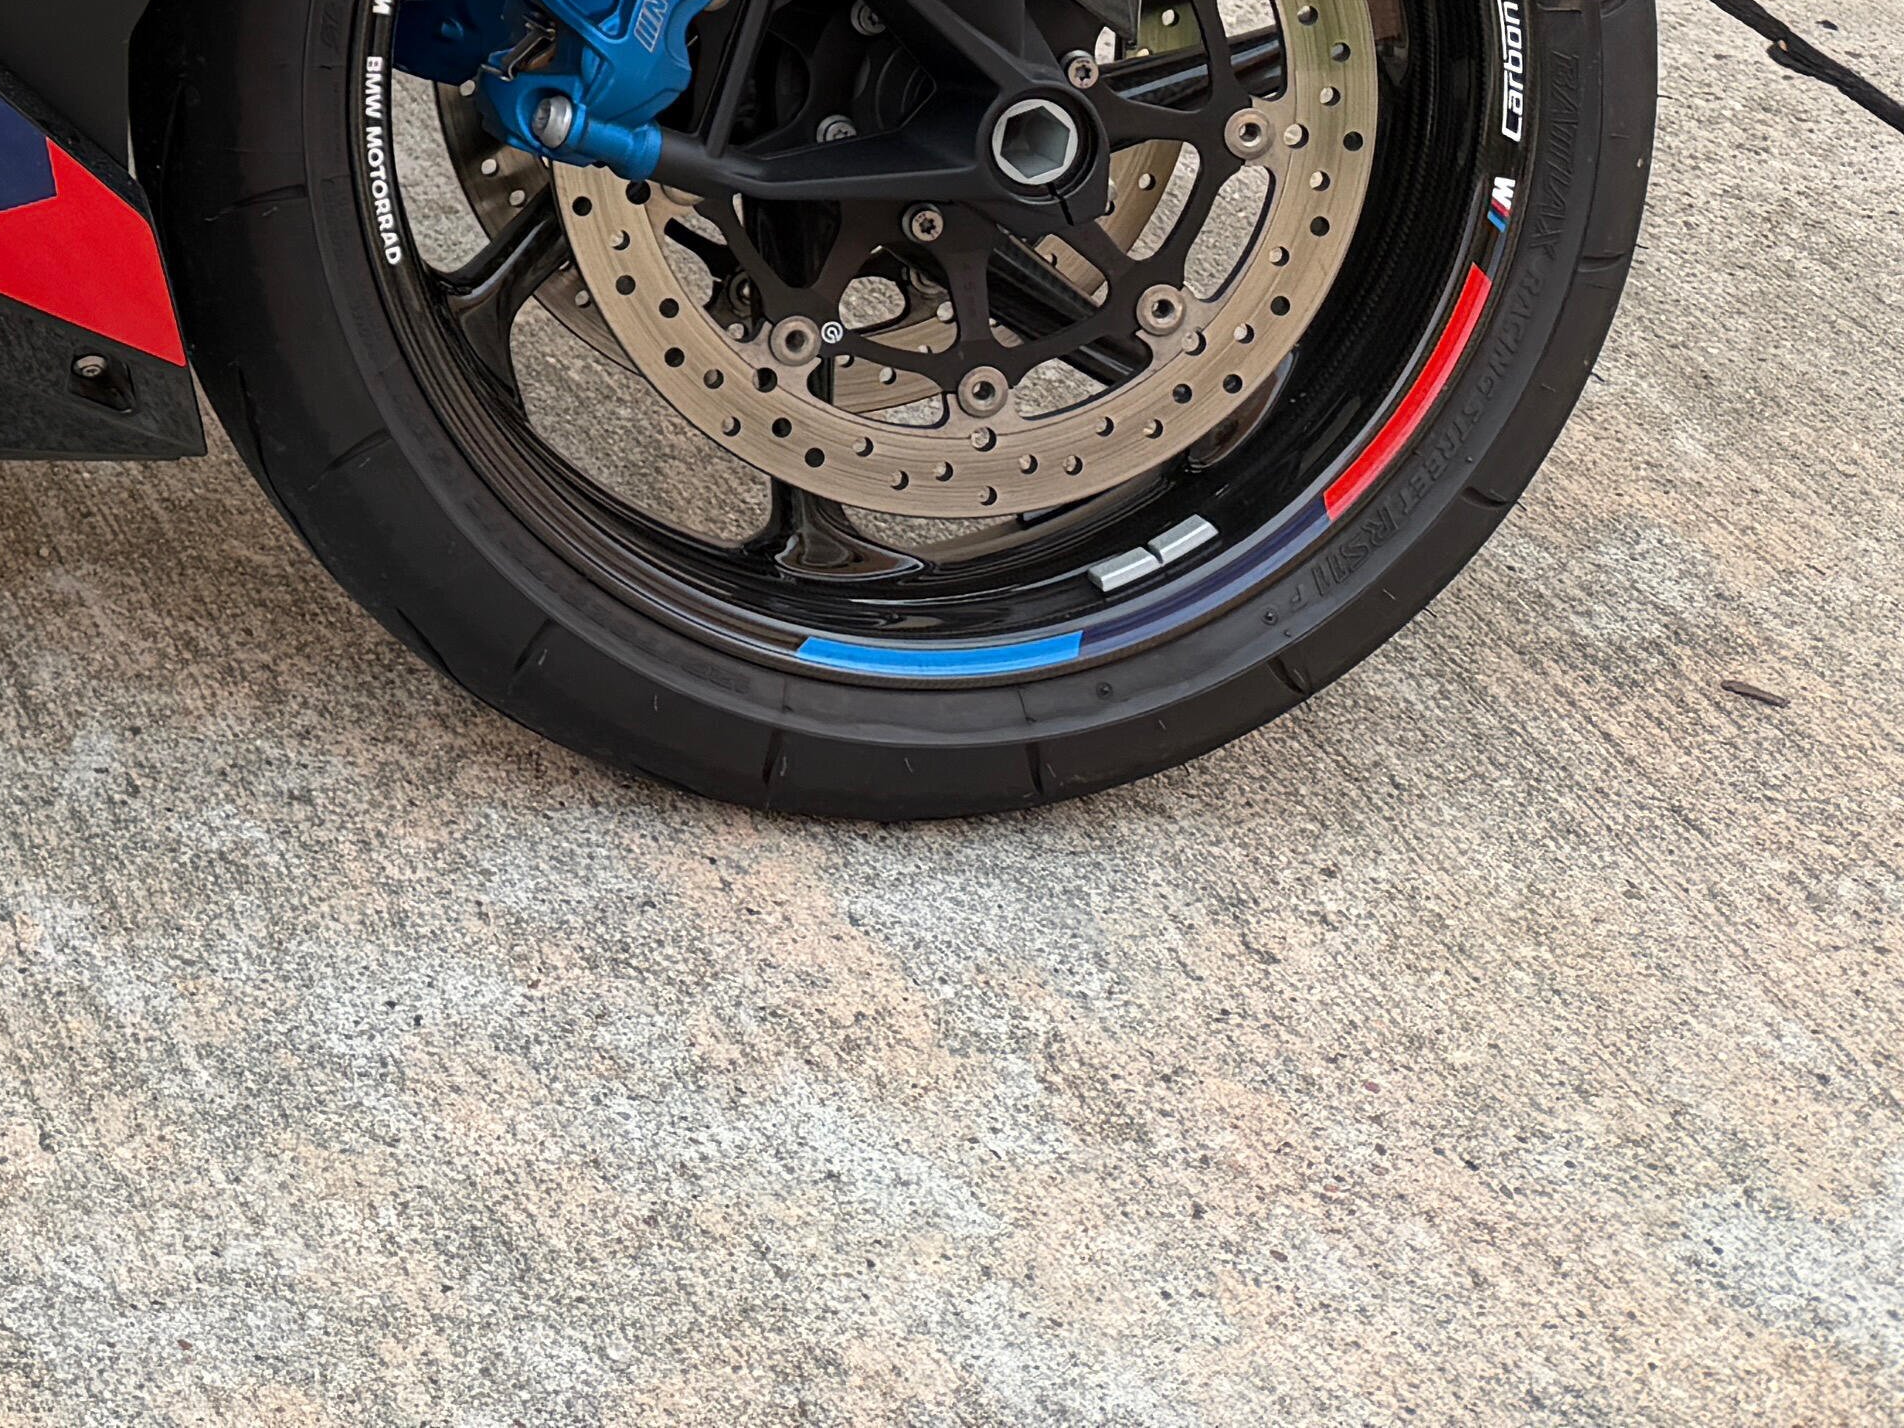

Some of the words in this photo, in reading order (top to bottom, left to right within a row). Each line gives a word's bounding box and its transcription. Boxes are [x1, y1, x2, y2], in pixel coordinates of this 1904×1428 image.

[365, 56, 383, 119] BMW
[366, 125, 402, 266] MOTORRAD
[1480, 270, 1543, 398] RACING
[1410, 396, 1485, 520] STREET
